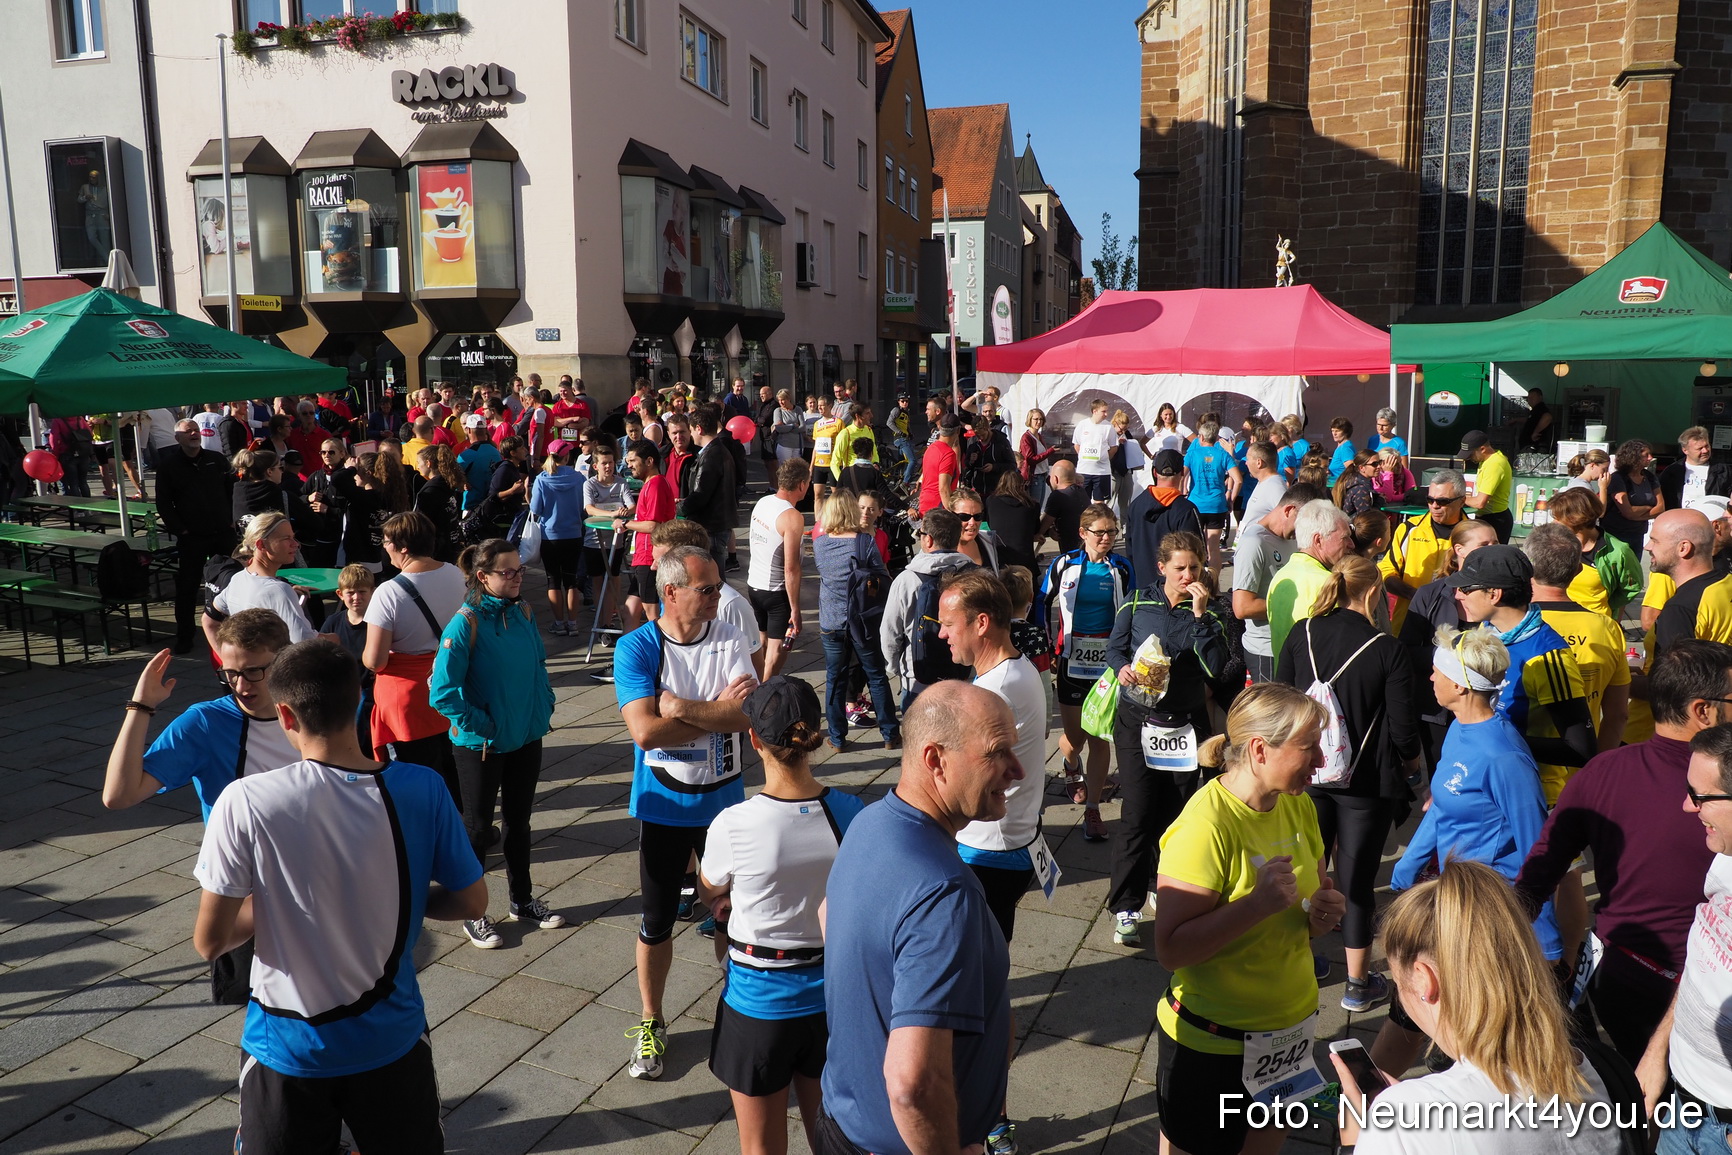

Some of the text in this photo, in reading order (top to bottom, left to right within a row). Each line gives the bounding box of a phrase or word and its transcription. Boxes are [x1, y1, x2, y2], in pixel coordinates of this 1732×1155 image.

[391, 62, 509, 102] RACKL
[439, 101, 507, 120] Rathaus
[312, 173, 347, 185] 100 Jahre
[309, 186, 343, 206] RACKL
[966, 235, 977, 318] satzke
[241, 299, 274, 307] Toiletten
[1580, 307, 1695, 316] Neumarkter
[118, 341, 212, 352] Neumarkter
[107, 350, 244, 363] Lammsbräu
[461, 351, 485, 364] RACKL
[1075, 648, 1107, 662] 2482
[1083, 667, 1098, 675] Irene
[1149, 735, 1188, 751] 3006
[657, 750, 693, 761] Christian
[1271, 1027, 1304, 1047] BOCK
[1253, 1038, 1309, 1079] 2542
[1268, 1082, 1295, 1101] Sonja
